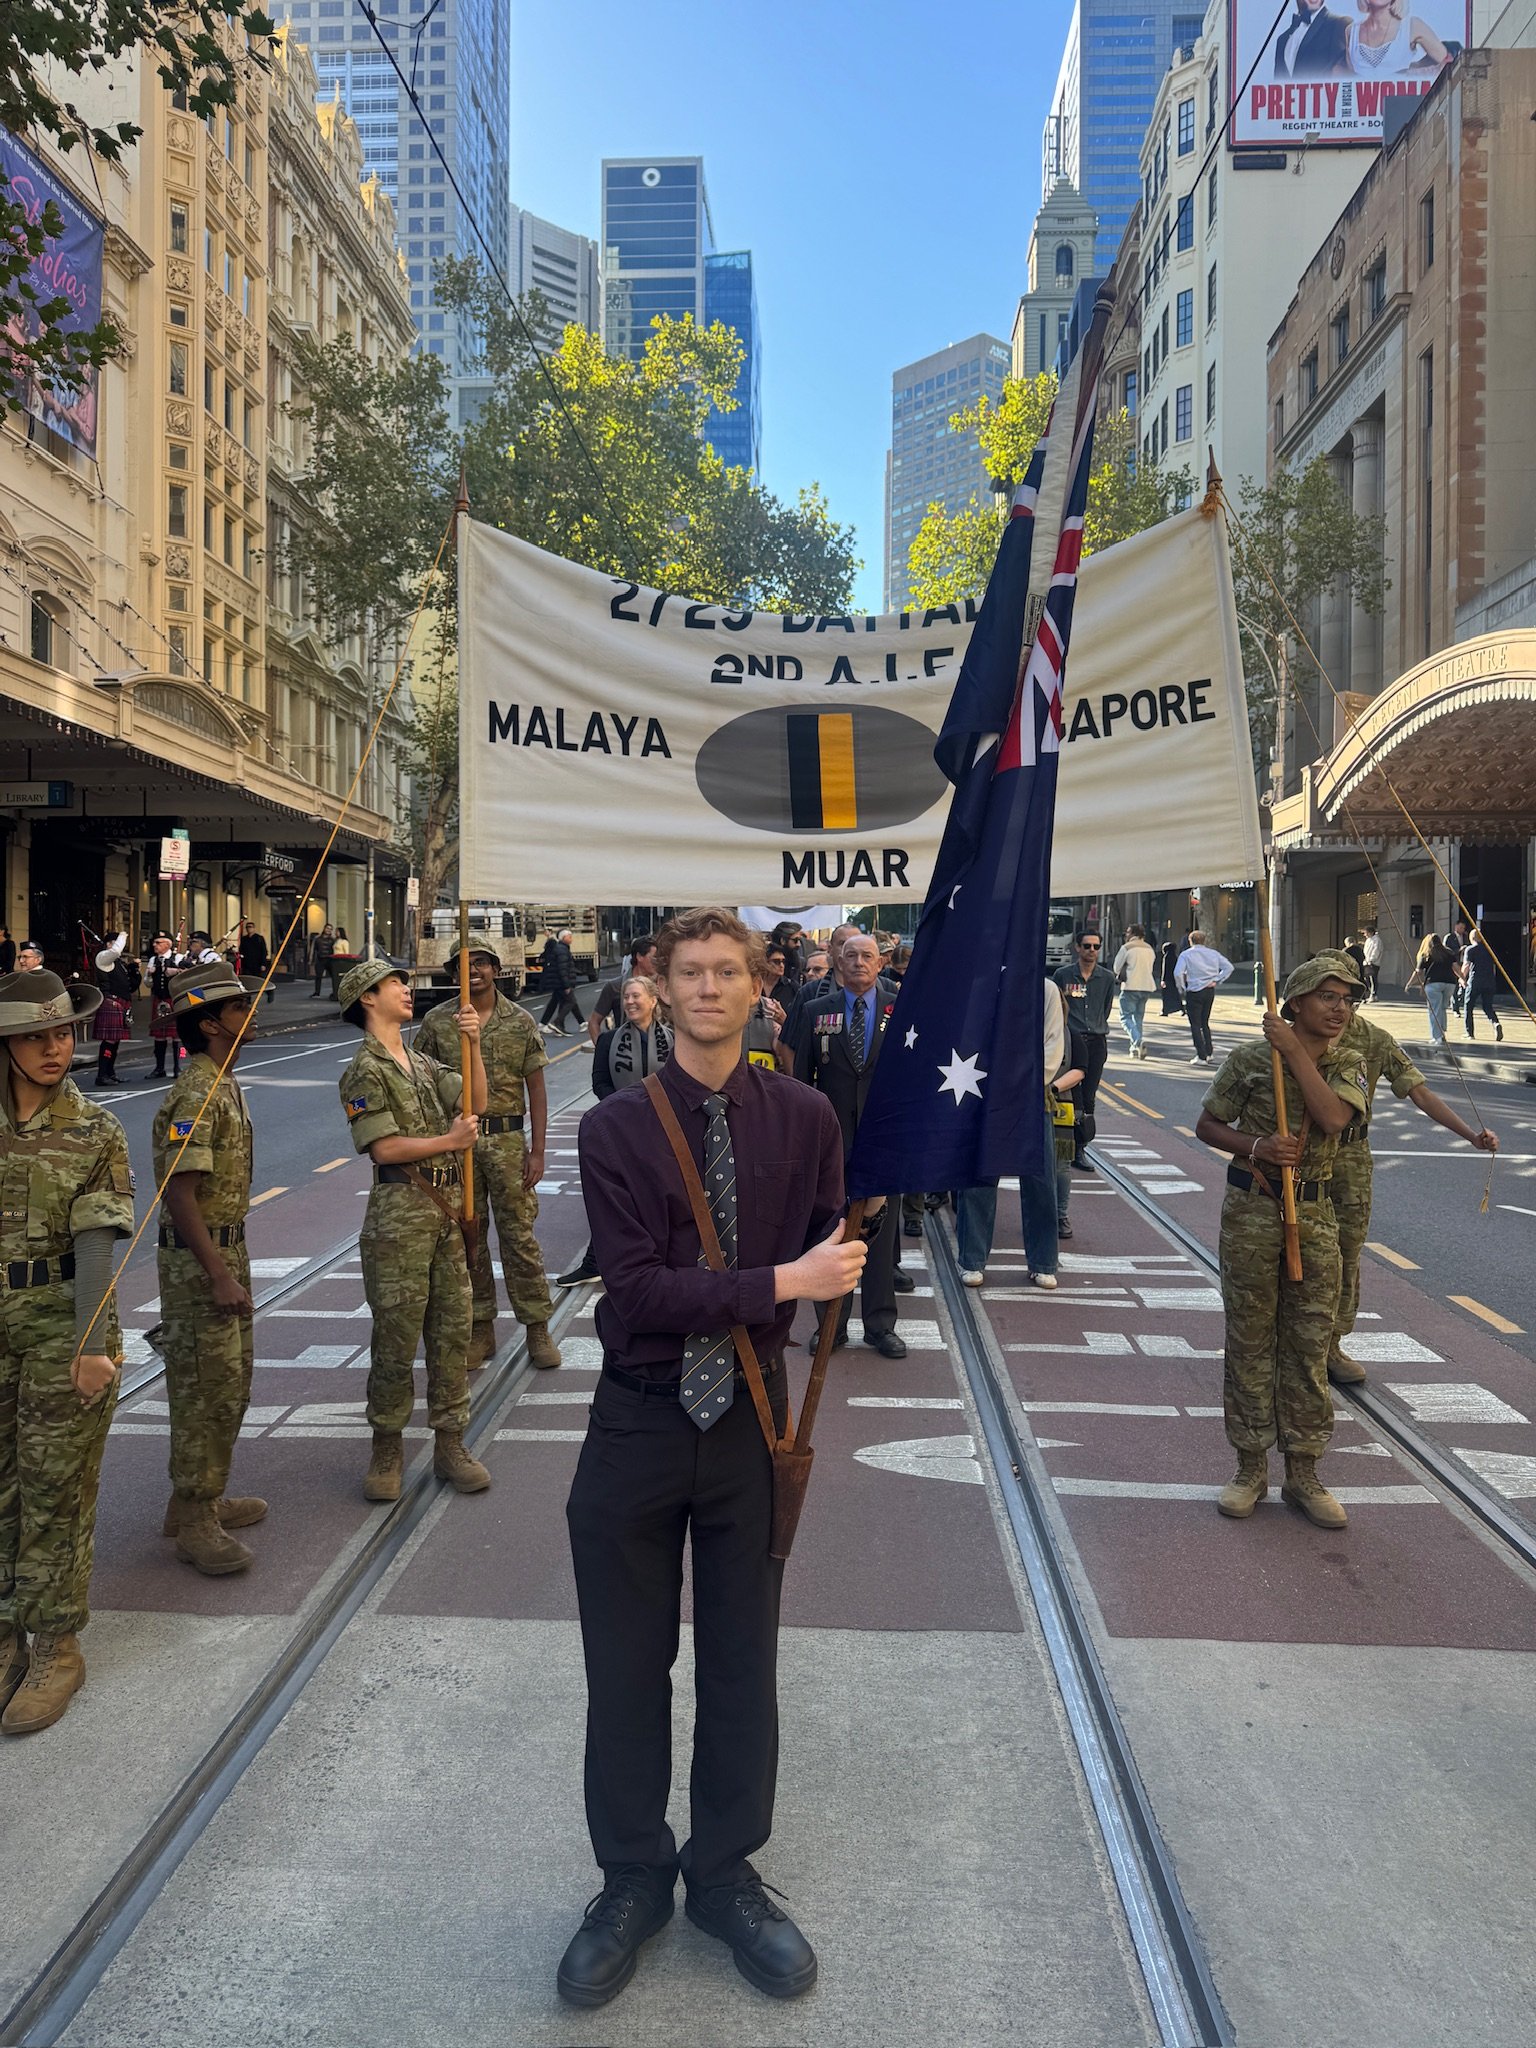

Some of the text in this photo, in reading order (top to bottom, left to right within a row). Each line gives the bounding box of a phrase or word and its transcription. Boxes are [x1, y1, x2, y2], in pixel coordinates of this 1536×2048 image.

[1251, 82, 1340, 120] PRETTY
[1282, 122, 1317, 131] REGENT
[1319, 120, 1359, 130] THEATRE
[1435, 646, 1508, 689] THEATRE
[489, 679, 1216, 759] MALAYA APORE
[264, 853, 295, 873] ERFORD
[782, 848, 911, 889] MUAR
